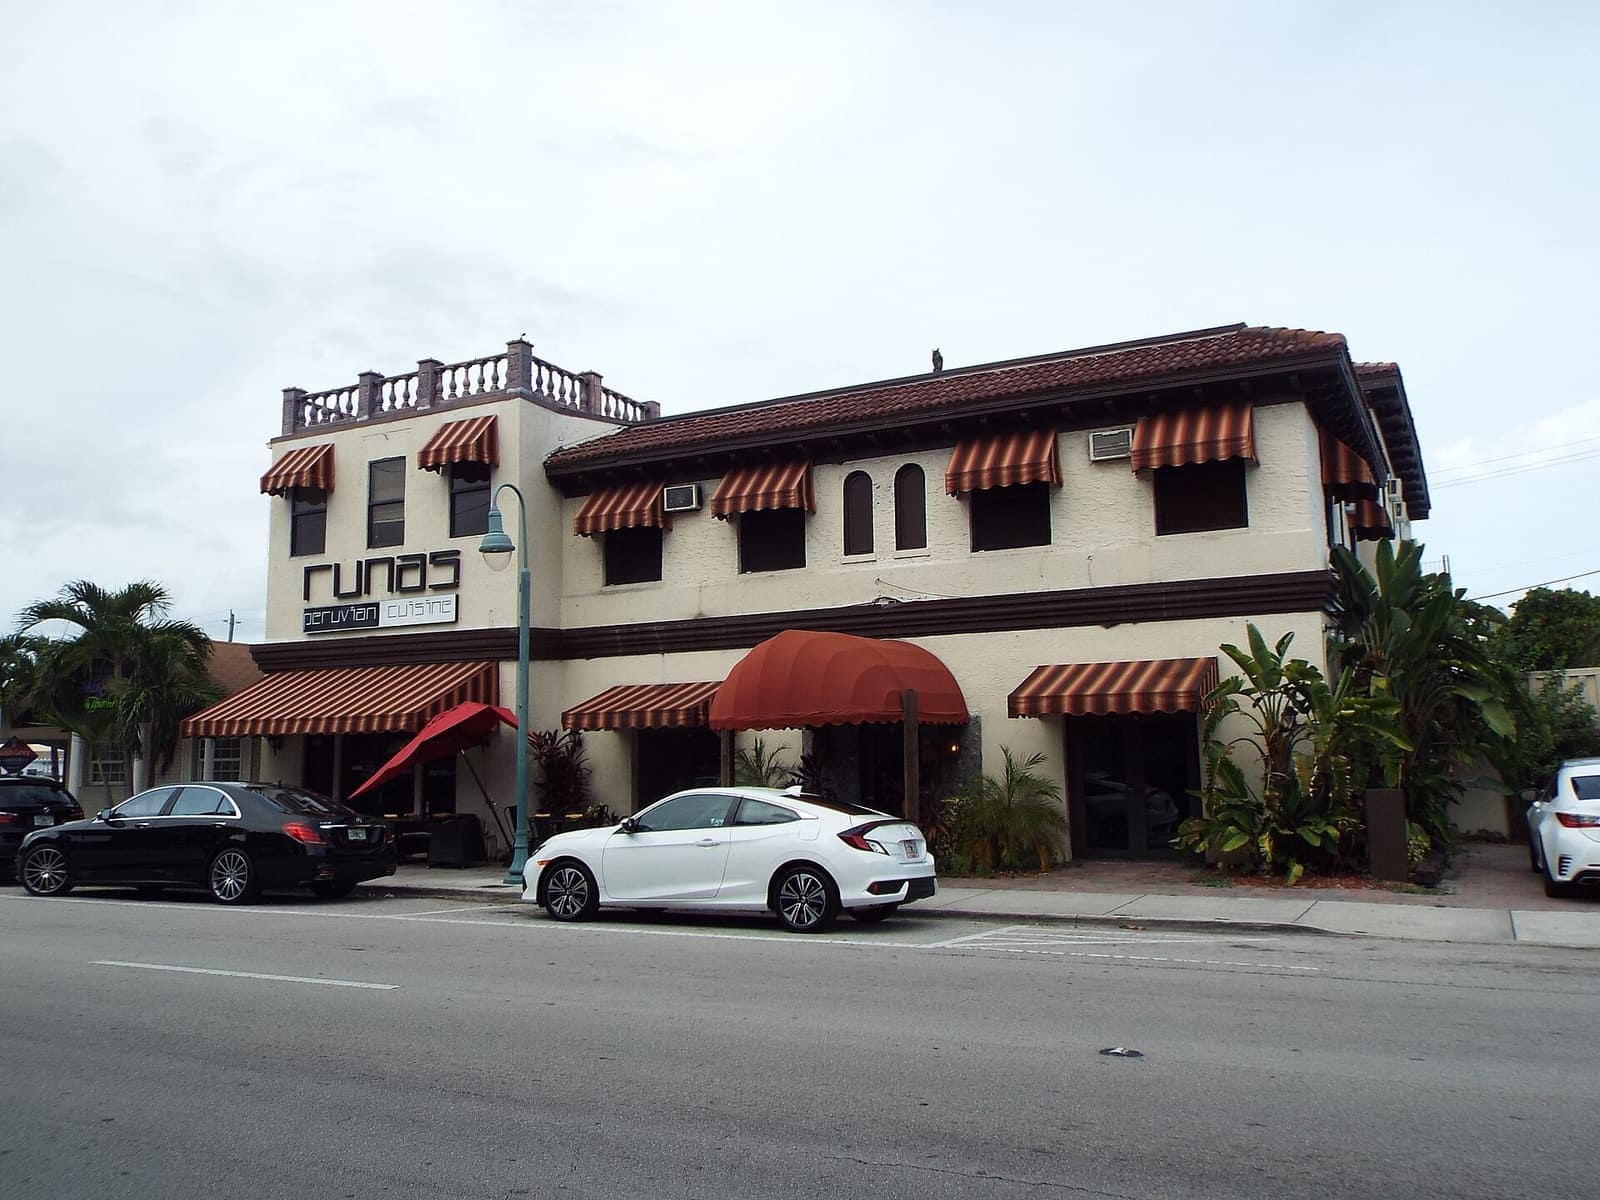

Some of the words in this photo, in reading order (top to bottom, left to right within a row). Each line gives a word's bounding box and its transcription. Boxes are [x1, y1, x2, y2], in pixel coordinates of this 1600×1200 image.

[304, 550, 461, 601] runas
[304, 606, 377, 626] peruvian
[387, 599, 452, 619] cuisine
